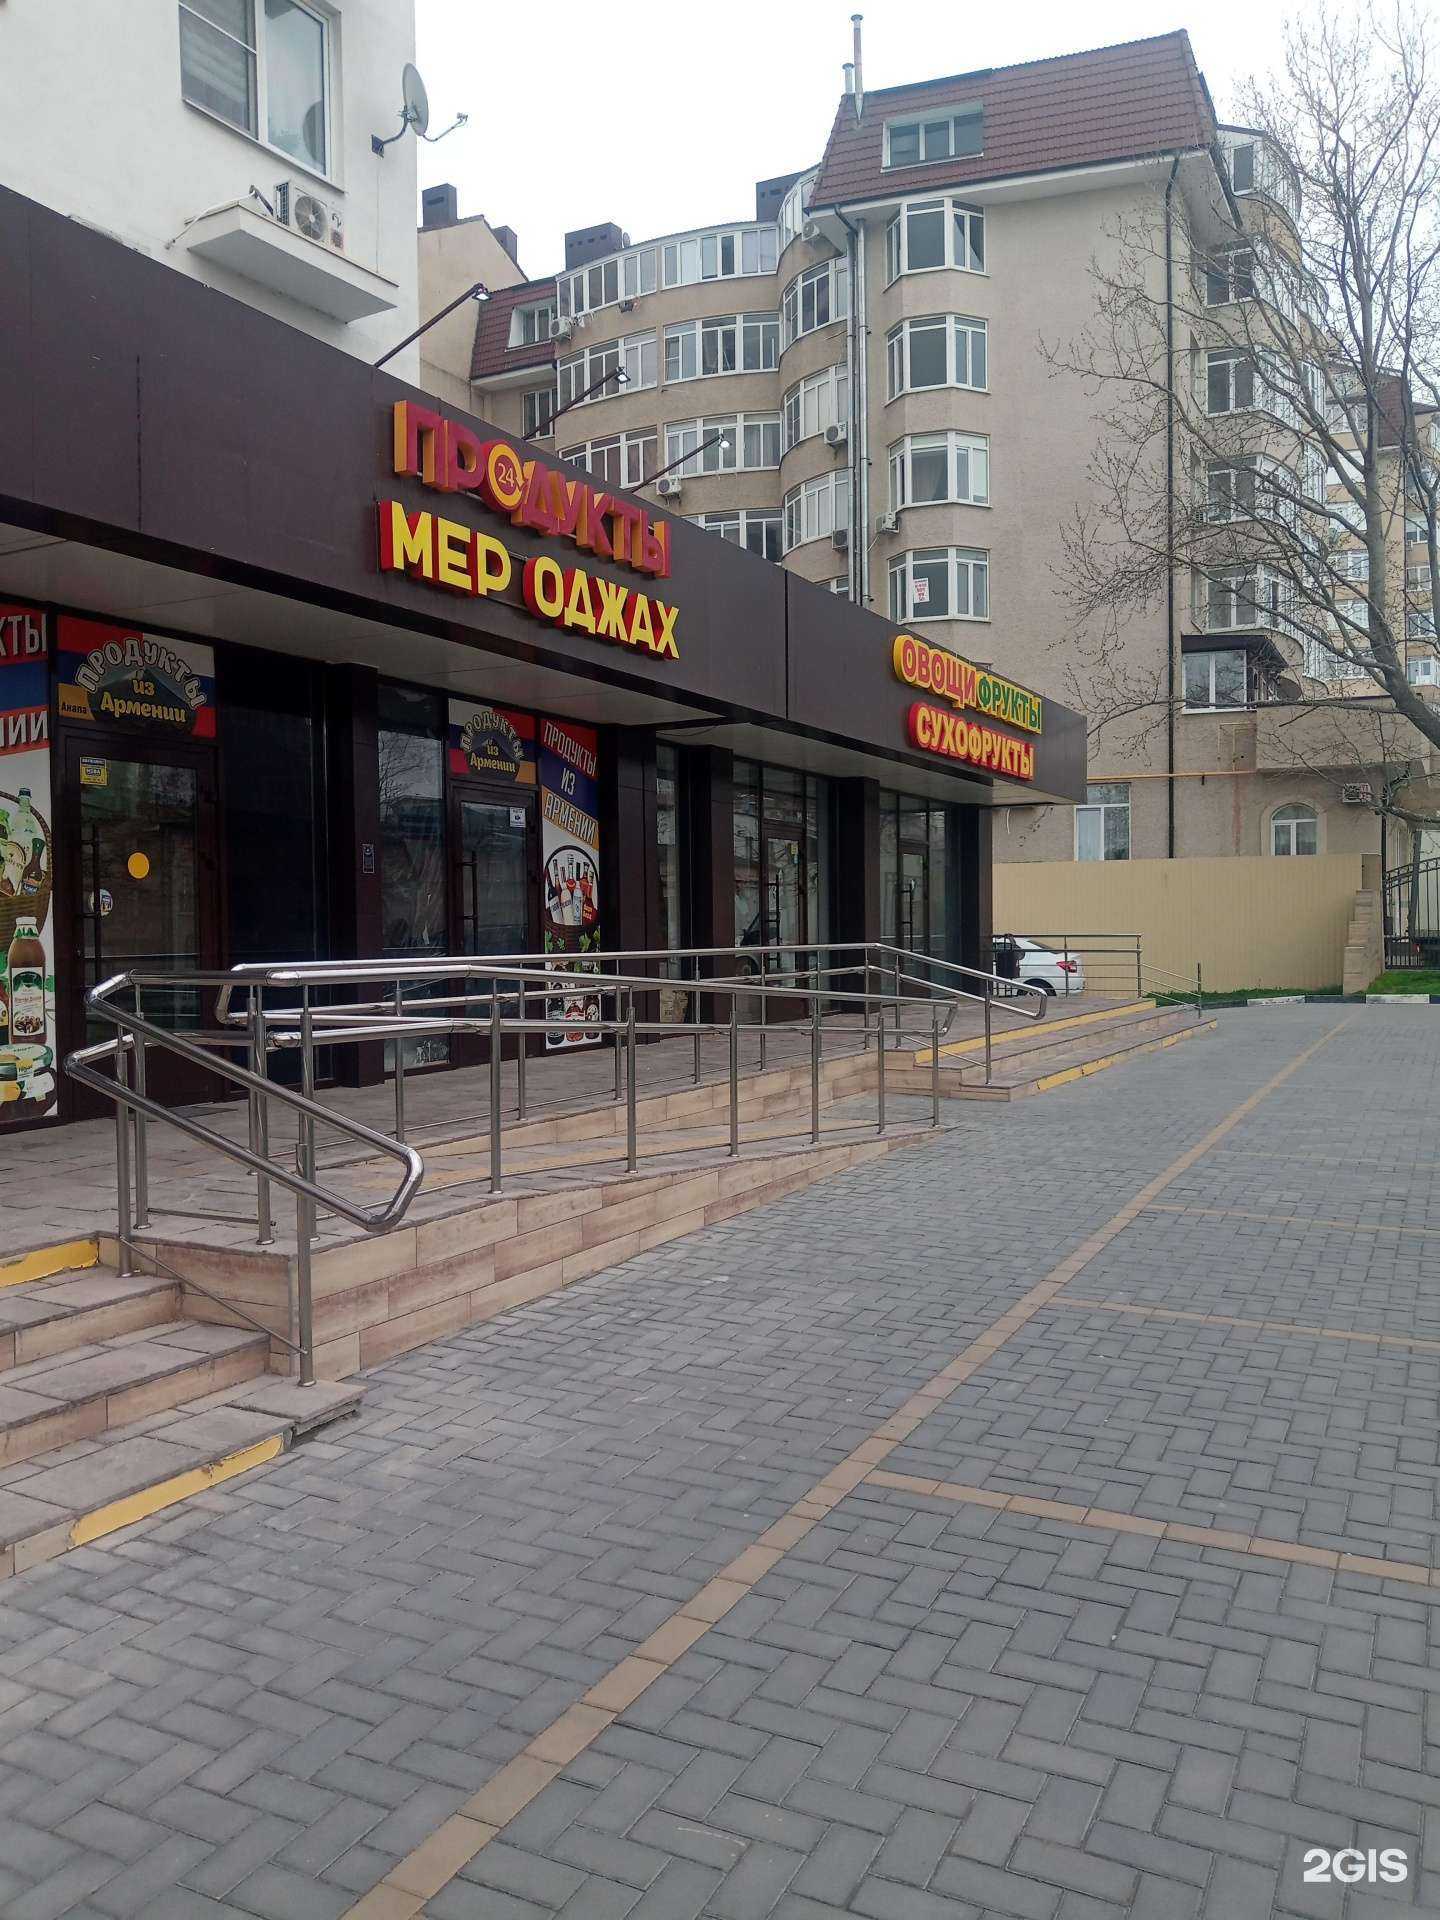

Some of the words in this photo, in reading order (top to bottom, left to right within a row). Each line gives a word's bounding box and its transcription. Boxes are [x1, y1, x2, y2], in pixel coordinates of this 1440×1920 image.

[394, 400, 672, 579] ПРОДУКТЫ
[496, 461, 515, 488] 24
[382, 500, 512, 597] МЕР
[526, 555, 680, 660] ОДЖАХ
[75, 638, 208, 710] ПРОДУКТЫ
[132, 678, 155, 697] из
[894, 635, 977, 709] ОВОЩИ
[976, 671, 1042, 734] ФРУКТЫ
[61, 701, 88, 714] Анапа
[100, 691, 187, 723] Армении
[460, 711, 524, 758] ПРОДУКТЫ
[487, 744, 499, 756] из
[544, 721, 597, 777] ПРОДУКТЫ
[910, 703, 1035, 781] СУХОФРУКТЫ
[470, 752, 516, 773] Армении
[560, 767, 577, 795] ИЗ
[544, 792, 597, 846] АРМЕНИИ
